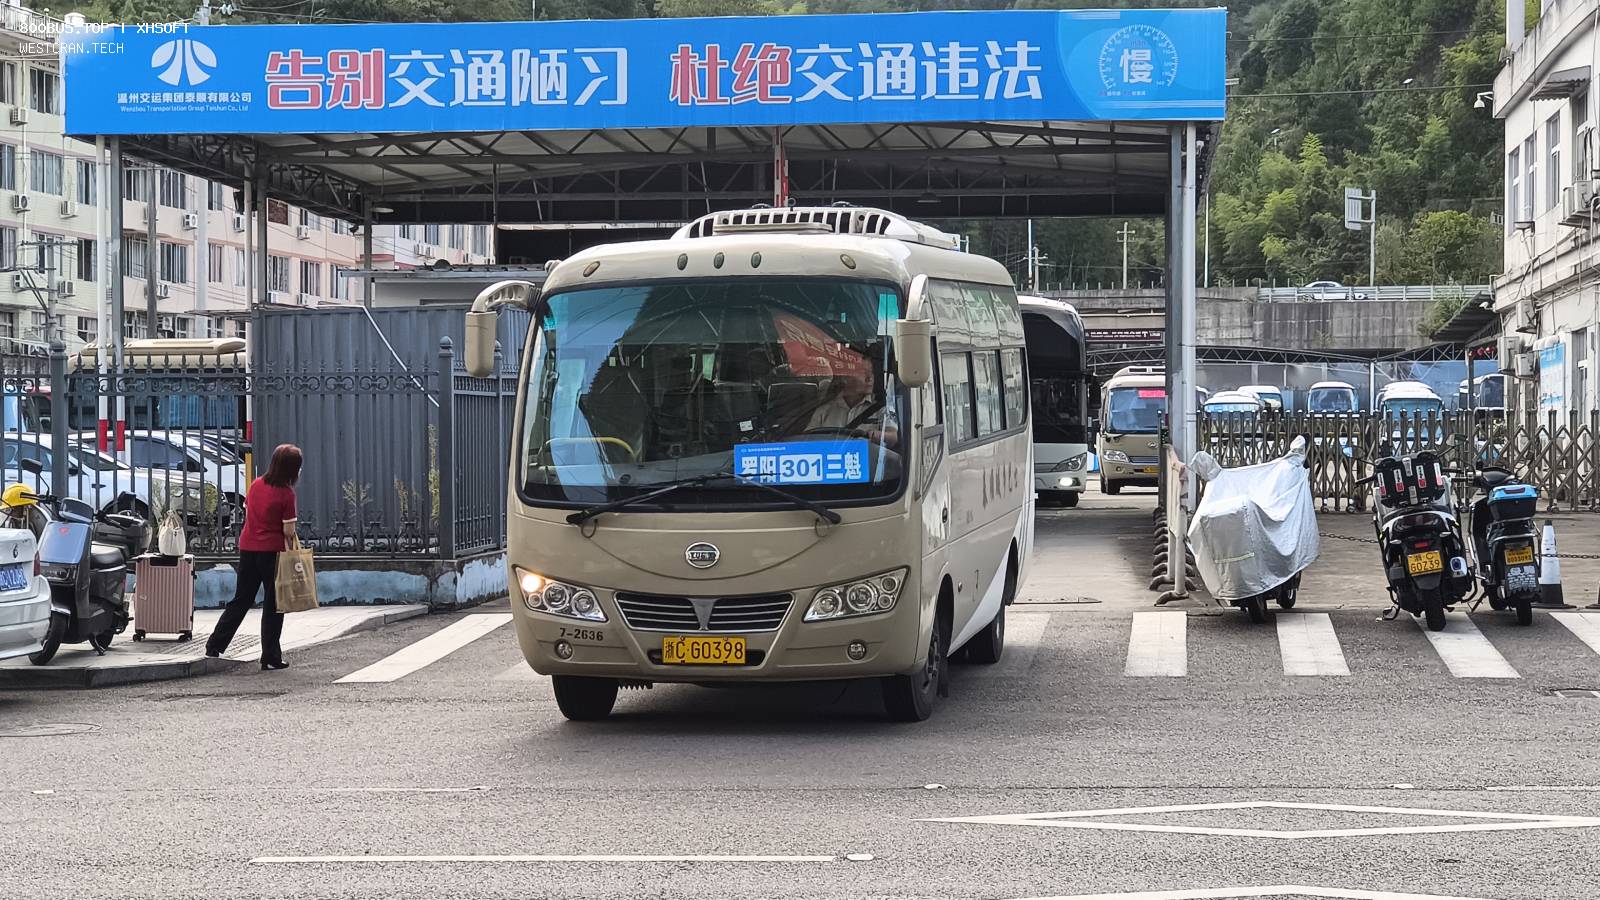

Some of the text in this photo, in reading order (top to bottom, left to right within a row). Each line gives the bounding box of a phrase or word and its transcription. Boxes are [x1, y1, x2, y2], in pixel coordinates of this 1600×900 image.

[1119, 48, 1154, 83] 慢
[117, 92, 252, 104] 温州交运集团泰顺有限公司
[120, 105, 146, 113] Wenzhou
[187, 104, 205, 113] Group
[206, 104, 227, 112] Taishun
[559, 627, 605, 641] 7-2636
